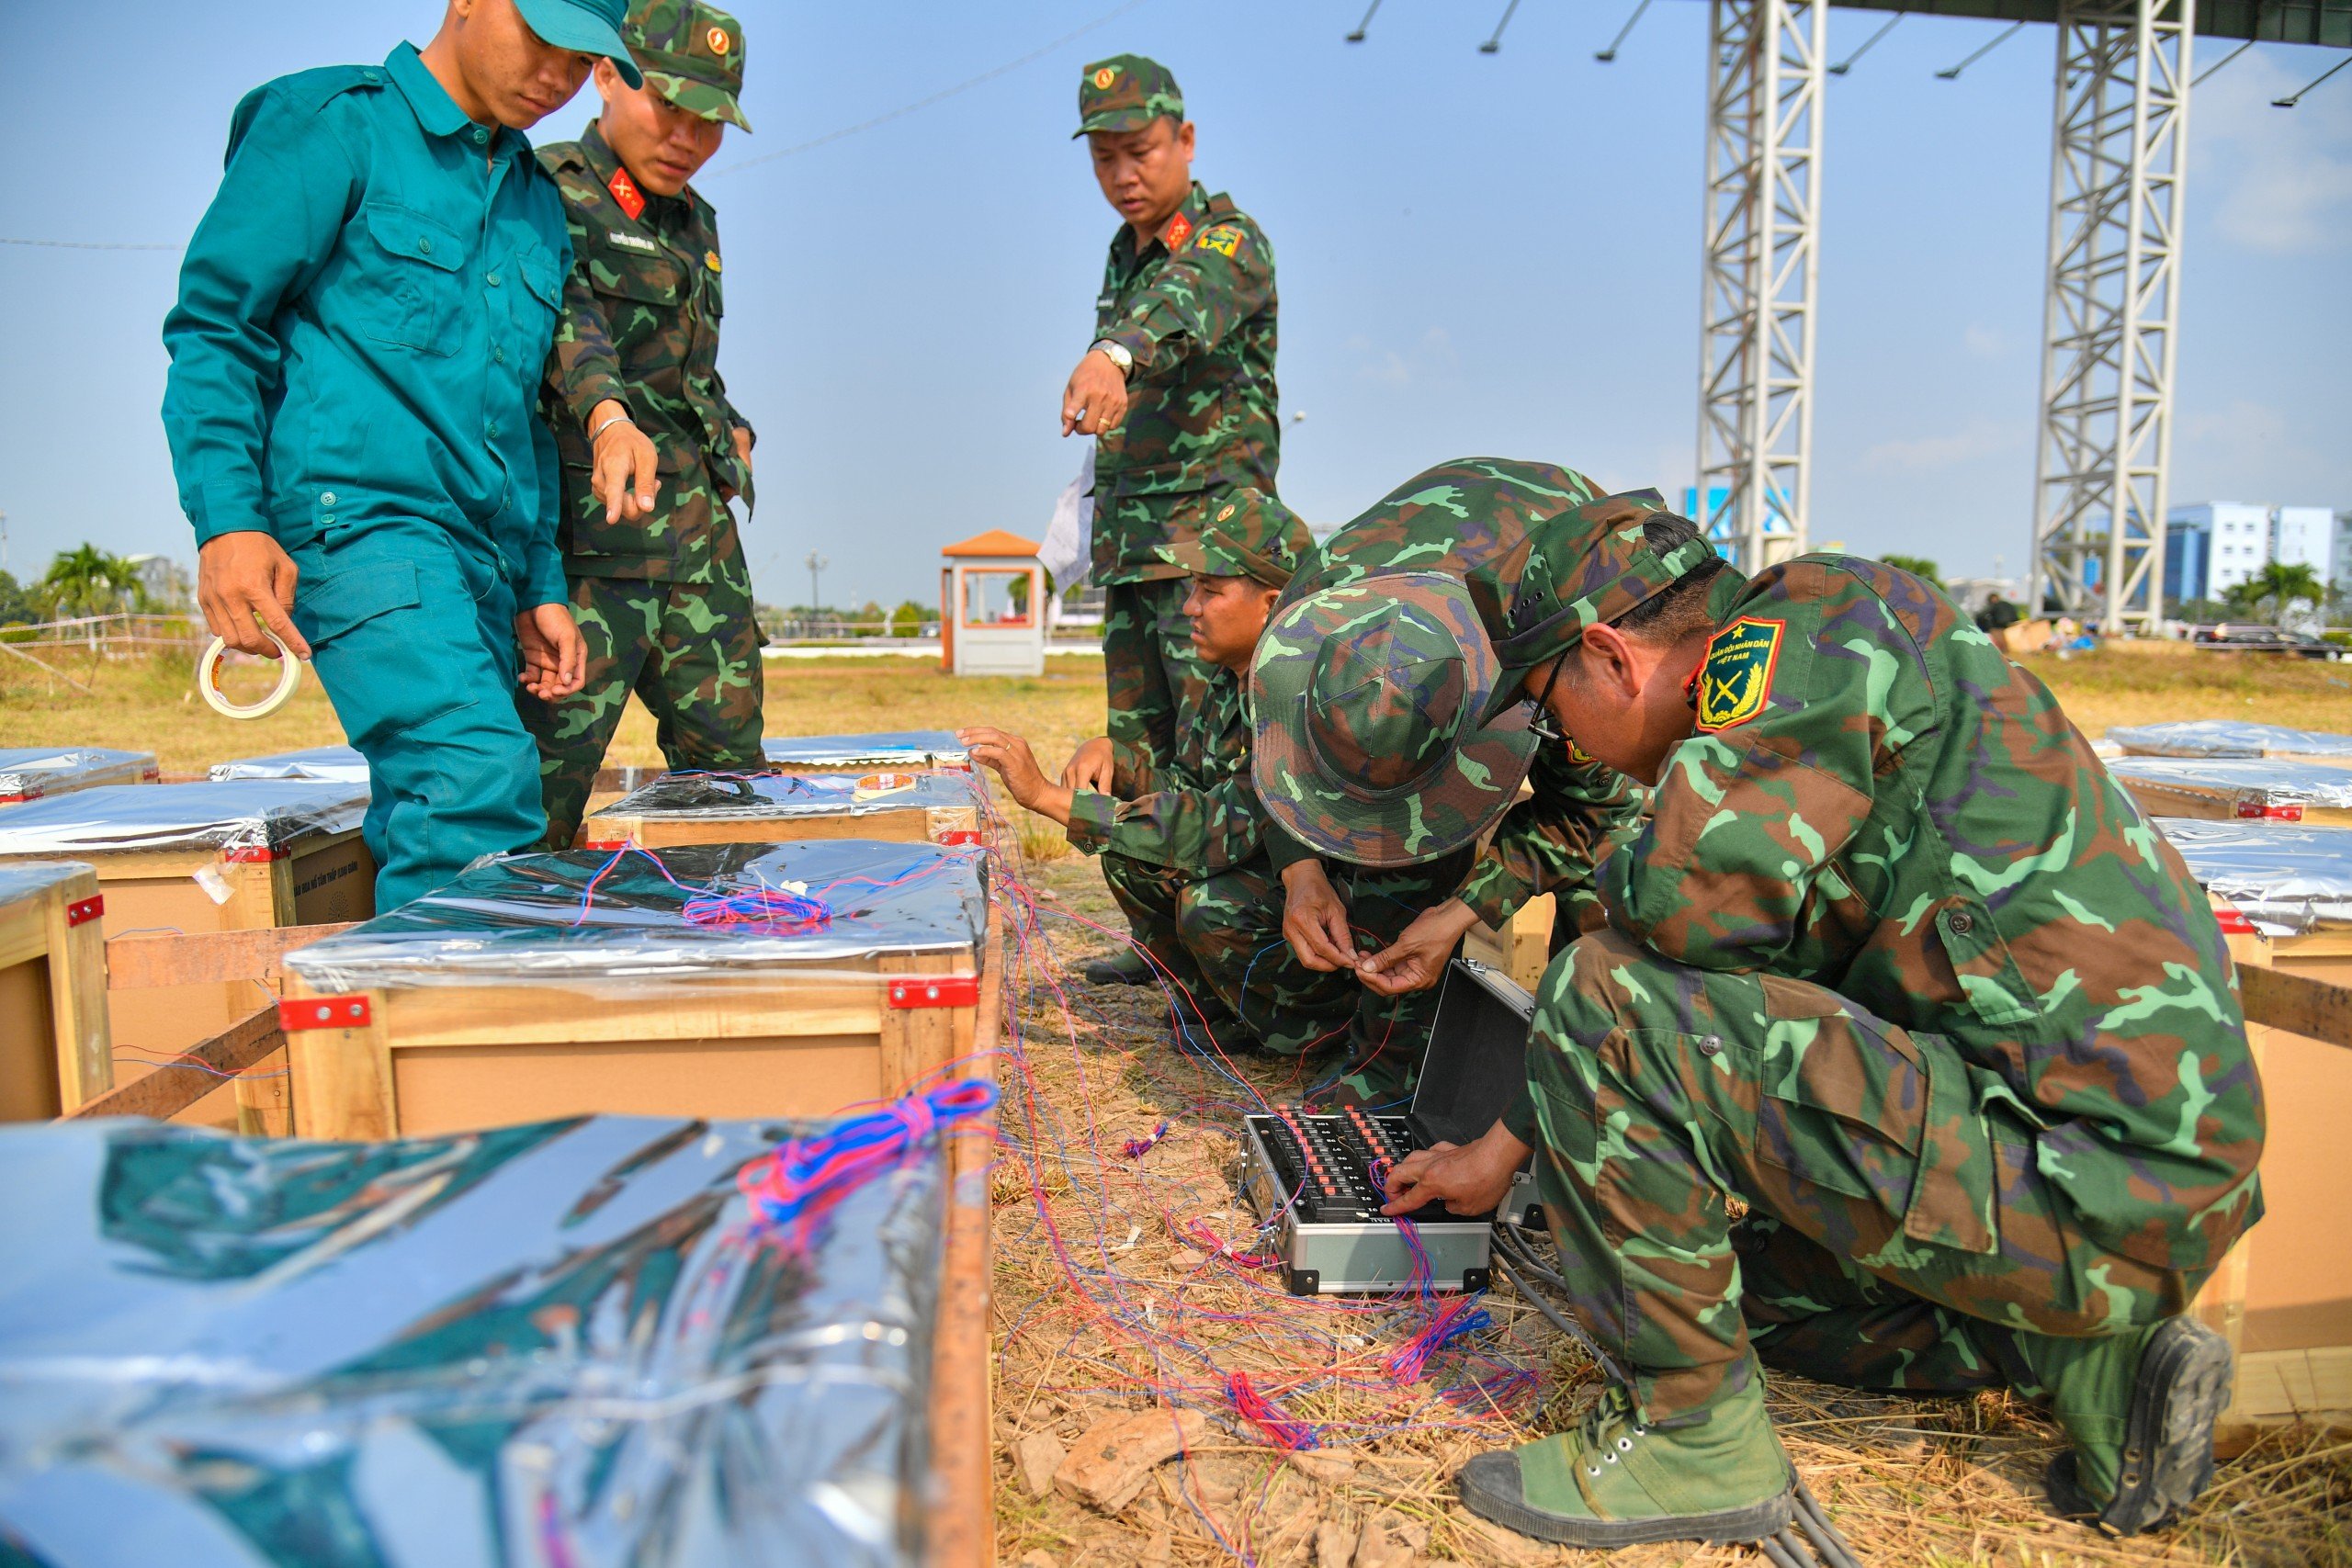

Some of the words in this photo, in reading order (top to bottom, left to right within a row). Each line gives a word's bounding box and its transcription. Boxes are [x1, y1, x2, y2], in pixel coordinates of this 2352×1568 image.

[1735, 640, 1753, 650] NHÂN
[1753, 638, 1770, 648] DÂN
[1732, 651, 1750, 661] NAM
